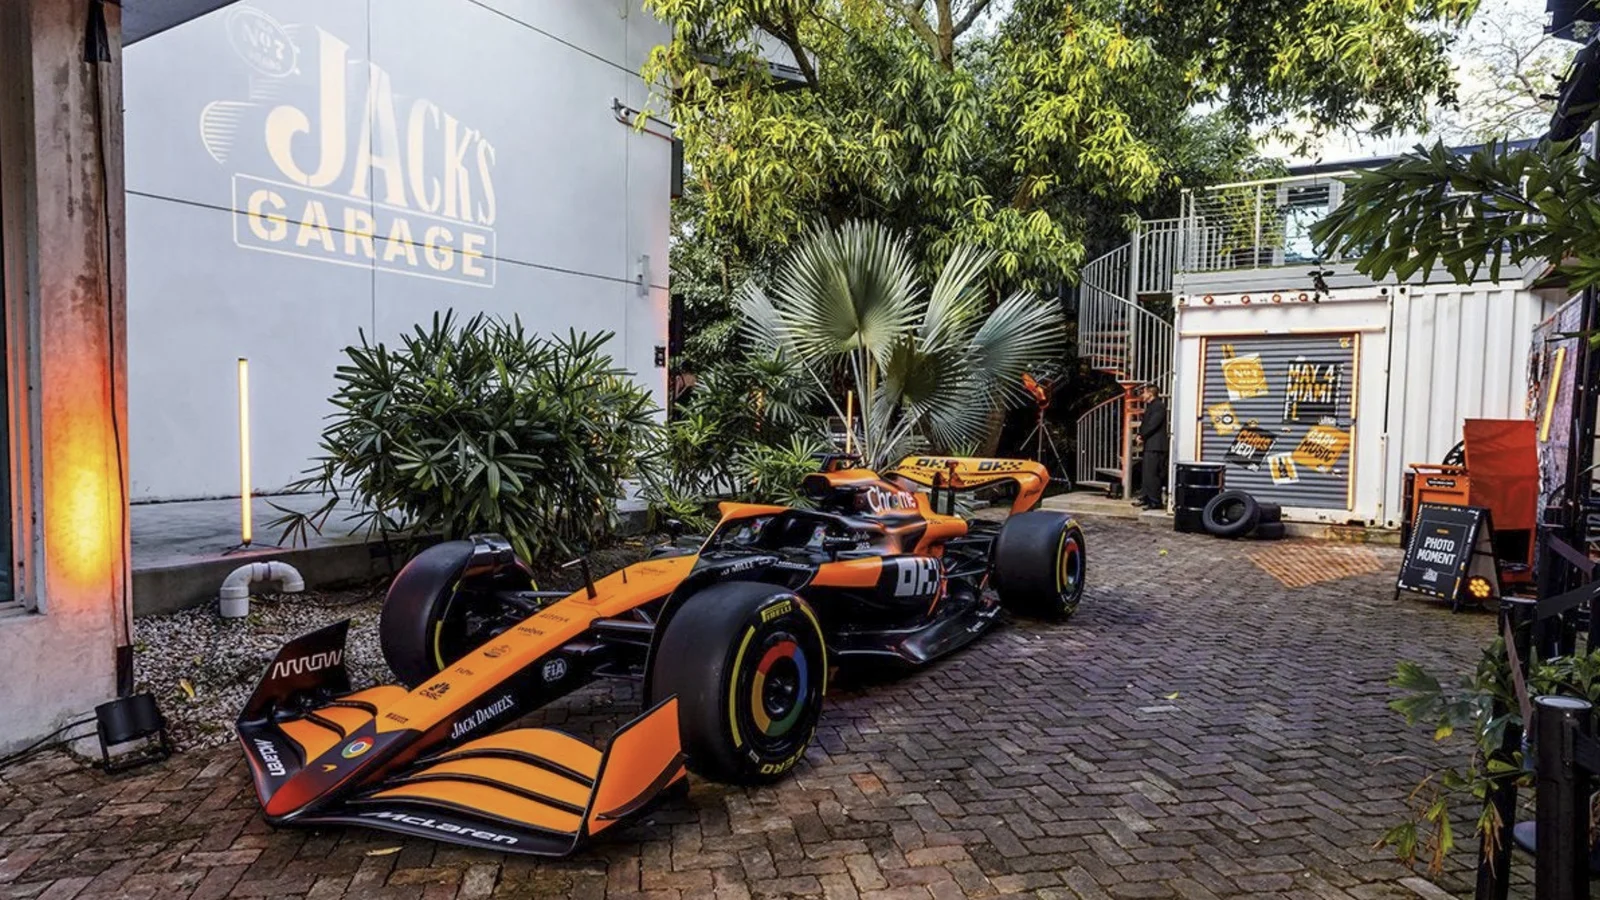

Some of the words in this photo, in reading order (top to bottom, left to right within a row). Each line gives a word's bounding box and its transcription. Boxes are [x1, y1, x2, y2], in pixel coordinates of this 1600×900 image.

[265, 25, 496, 226] JACK'S
[248, 190, 486, 277] GARAGE
[1289, 363, 1320, 383] MAY
[1324, 364, 1336, 383] 4
[1286, 383, 1333, 403] MIAMI
[1284, 401, 1300, 421] FL
[1231, 441, 1256, 460] JEDI
[1301, 440, 1335, 462] MUSIC
[978, 461, 1023, 471] OKX
[867, 486, 916, 512] Chrome
[1424, 536, 1455, 552] PHOTO
[1416, 548, 1456, 566] MOMENT
[760, 600, 792, 623] PIRELLI
[271, 649, 343, 680] ARROW
[543, 660, 567, 682] FIA
[451, 713, 478, 740] JACK
[476, 694, 515, 725] DANIEL'S
[254, 737, 286, 777] McLaren
[359, 811, 519, 845] McLaren
